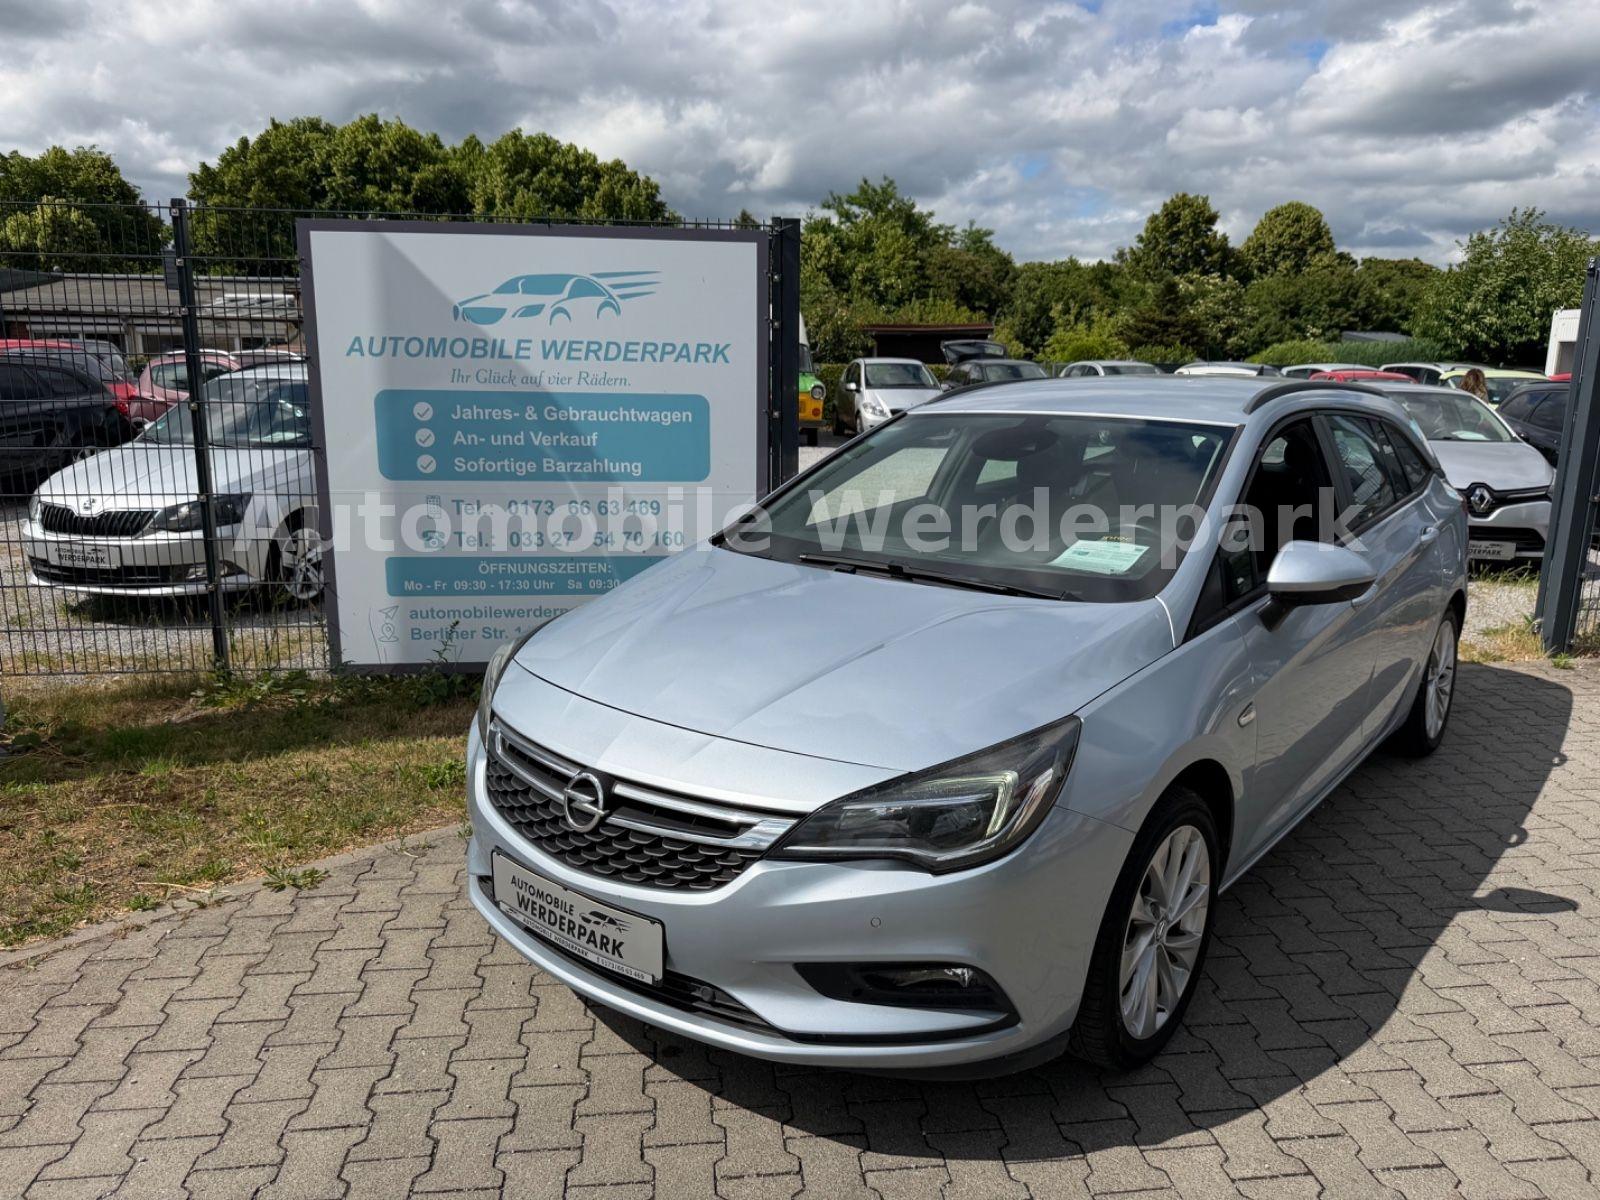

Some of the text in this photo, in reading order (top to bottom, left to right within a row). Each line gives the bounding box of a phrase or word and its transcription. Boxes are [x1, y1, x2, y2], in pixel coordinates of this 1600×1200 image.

[346, 336, 731, 364] AUTOMOBILE WERDERPARK
[451, 368, 632, 387] Ihr Glück auf vier Rädern.
[451, 405, 693, 426] Jahres- & Gebrauchtwagen
[453, 431, 598, 447] An- und Verkauf
[454, 457, 642, 477] Sofortige Barzahlung
[508, 499, 555, 516] 0173
[568, 499, 591, 516] 66
[597, 499, 620, 516] 63
[627, 499, 661, 516] 469
[509, 531, 544, 547] 033
[551, 531, 574, 547] 27
[593, 530, 615, 547] 54
[623, 530, 644, 547] 70
[652, 530, 684, 547] 160
[478, 561, 612, 575] ÖFFNUNGSZEITEN:
[404, 580, 423, 591] Mo
[435, 581, 447, 591] Fr
[454, 580, 487, 591] 09:30
[498, 580, 530, 591] 17:30
[534, 579, 555, 590] Uhr
[567, 579, 583, 590] Sa
[410, 626, 476, 641] Berliner
[481, 626, 508, 640] Str.
[510, 875, 575, 916] AUTOMOBILE
[515, 891, 625, 960] WERDERPARK
